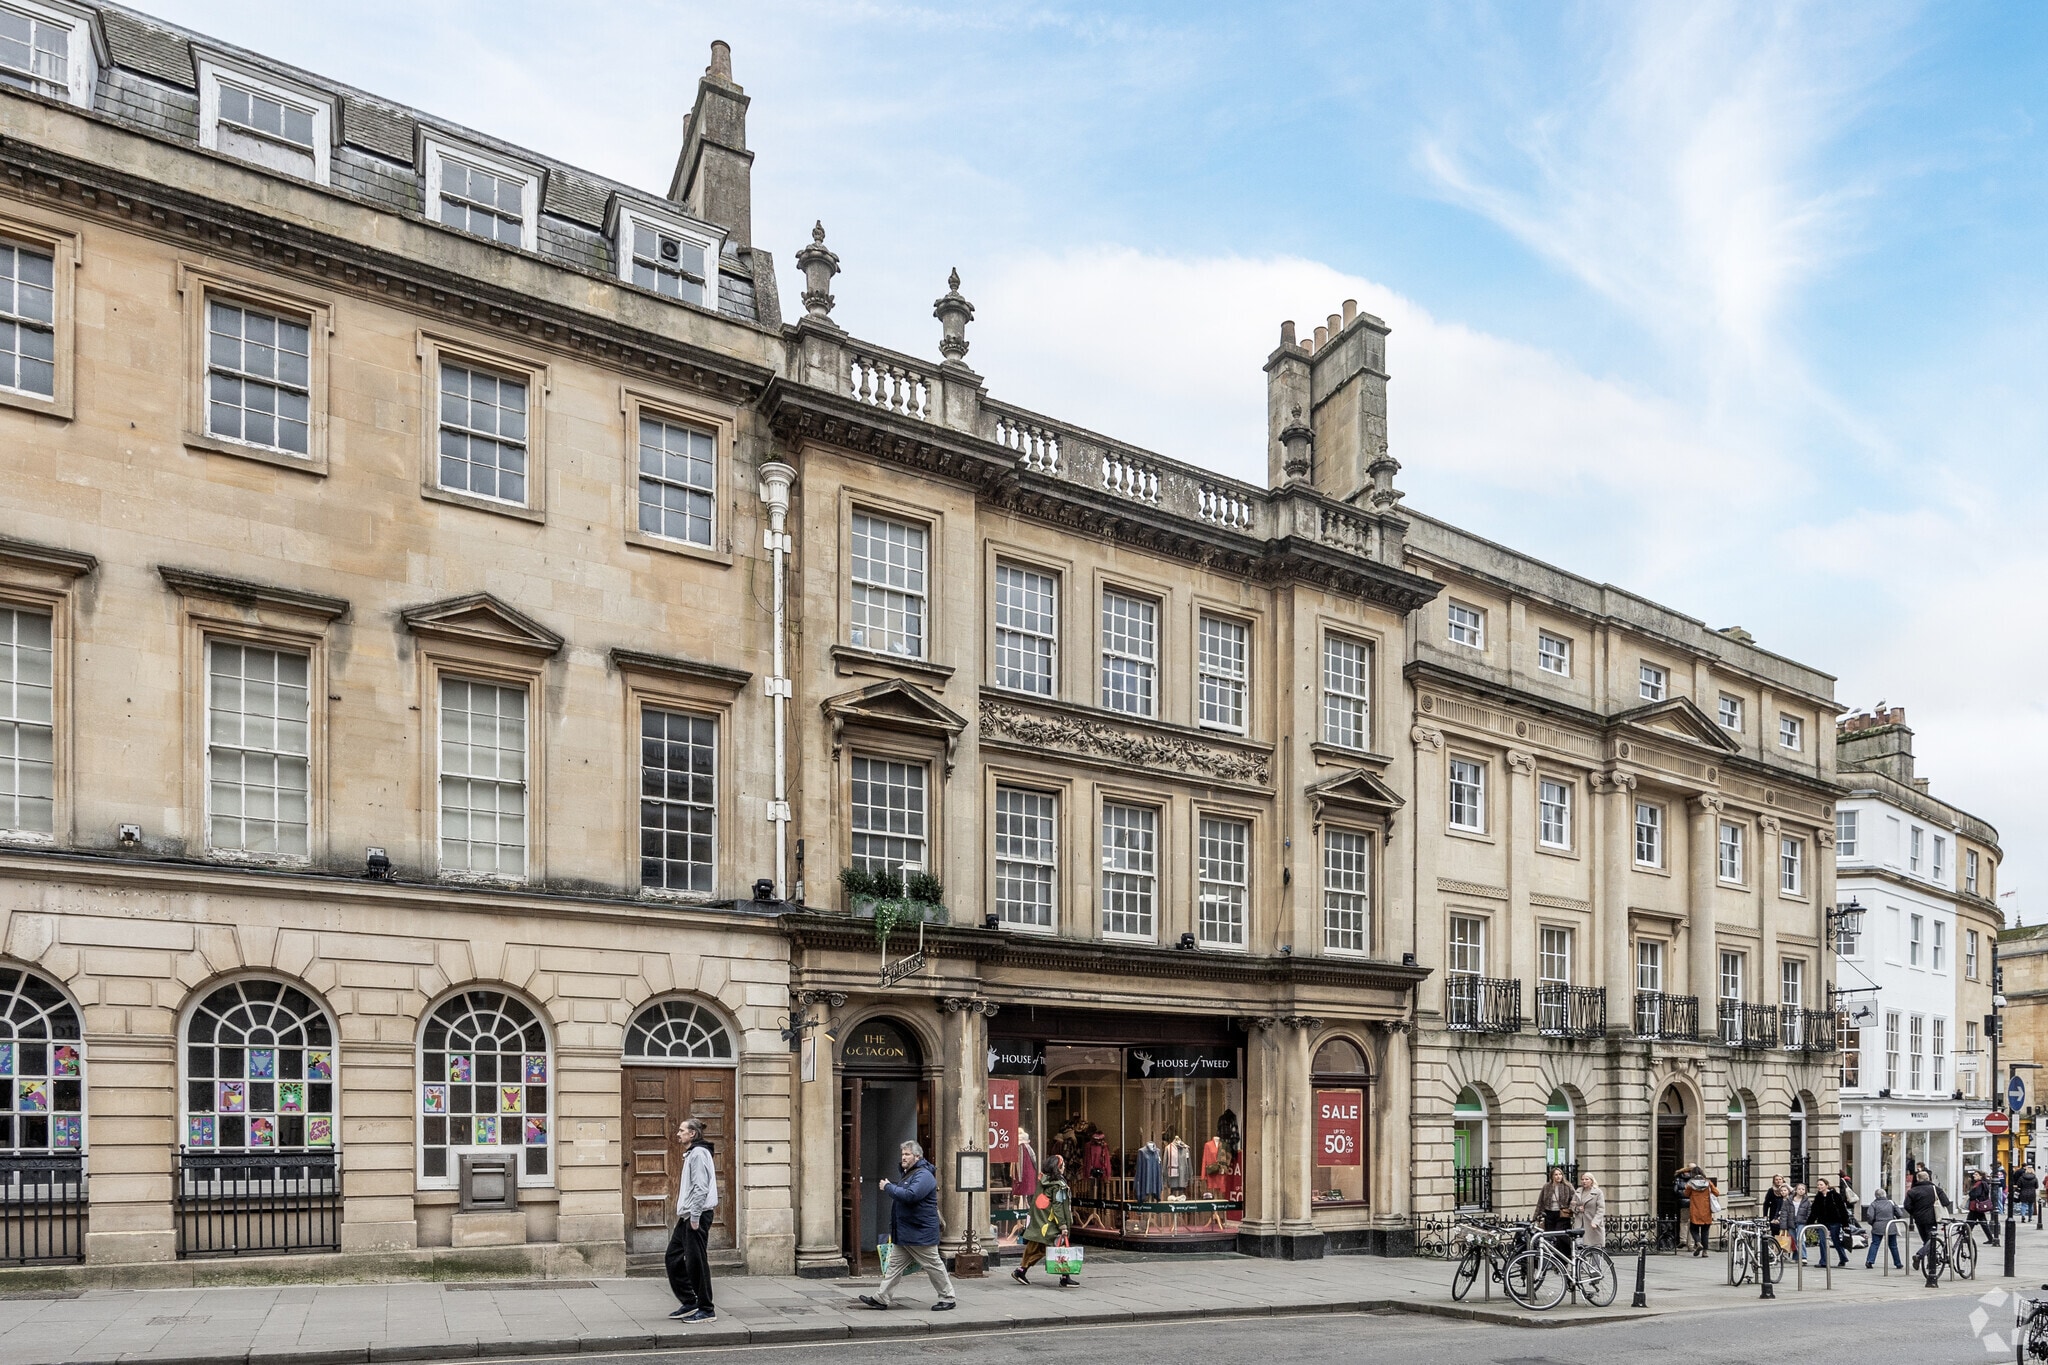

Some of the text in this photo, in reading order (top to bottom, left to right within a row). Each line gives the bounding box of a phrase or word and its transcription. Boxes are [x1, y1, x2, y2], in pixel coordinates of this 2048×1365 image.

[864, 1034, 886, 1044] THE
[846, 1046, 905, 1057] OCTAGON
[1002, 1054, 1031, 1064] HOUSE
[1028, 1052, 1042, 1073] of
[1157, 1055, 1229, 1076] HOUSE of TWEED
[988, 1094, 1015, 1110] LE
[1322, 1104, 1358, 1119] SALE
[1324, 1134, 1354, 1154] 50%
[1228, 1162, 1242, 1176] SA
